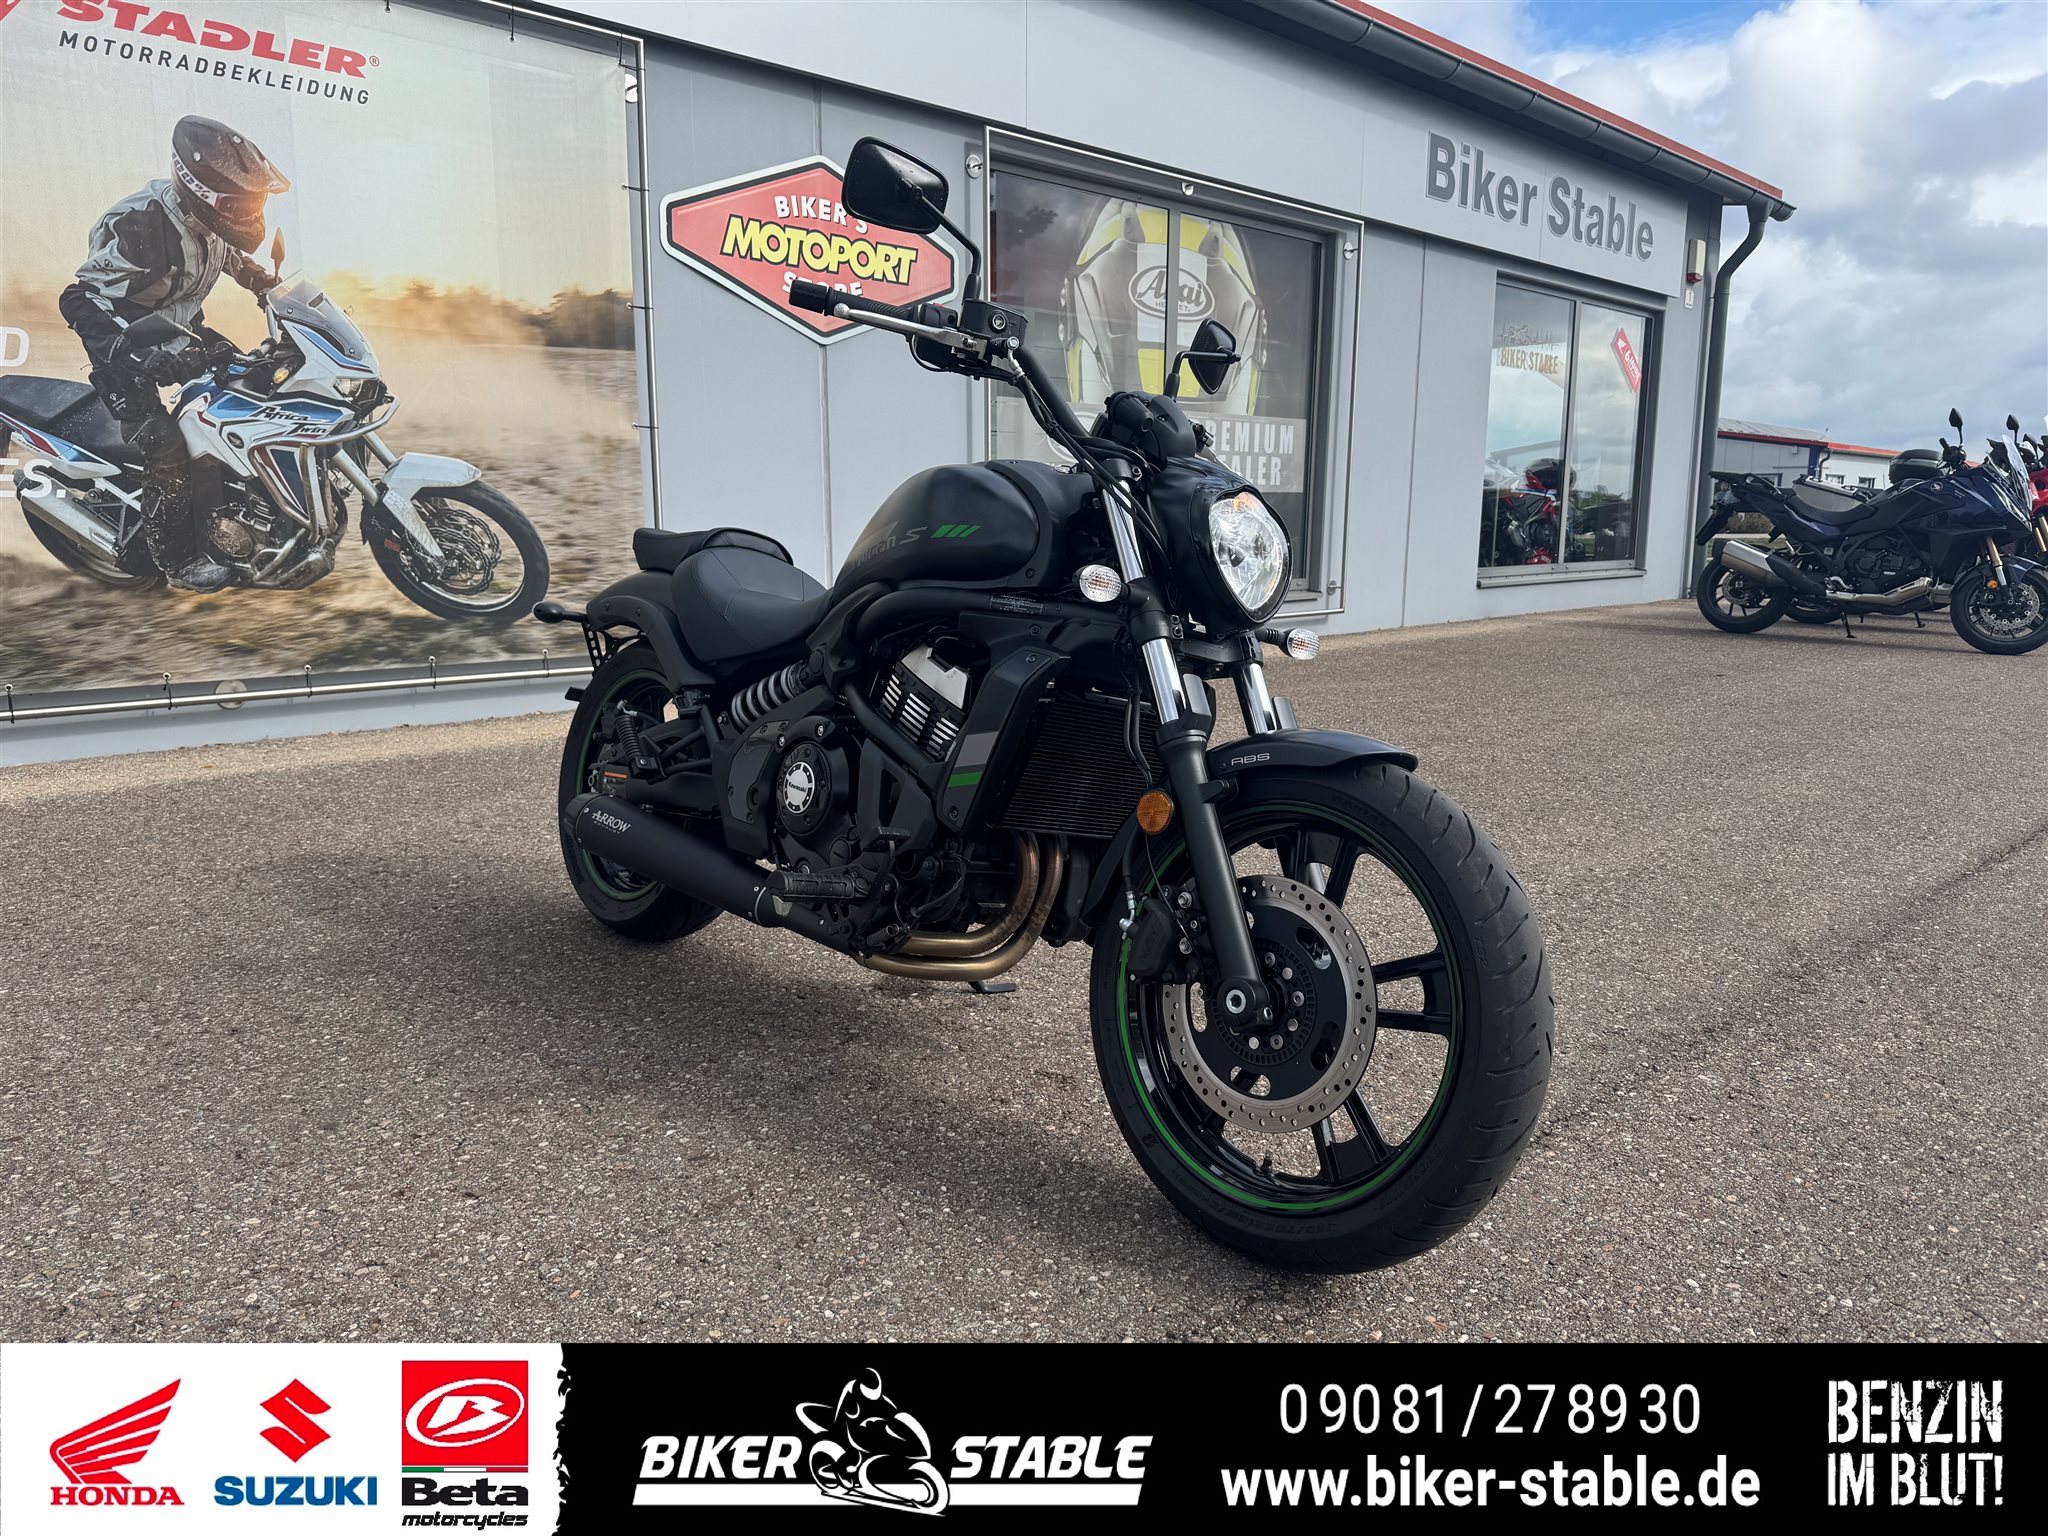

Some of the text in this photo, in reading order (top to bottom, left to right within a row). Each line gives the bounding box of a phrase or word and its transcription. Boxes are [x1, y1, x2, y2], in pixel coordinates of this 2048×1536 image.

[59, 30, 370, 105] MOTORRADBEKLEIDUNG
[1426, 130, 1654, 261] Biker Stable
[721, 215, 918, 285] MOTOPORT
[1135, 269, 1204, 307] Aai
[1501, 347, 1527, 370] BIKER
[249, 405, 310, 421] Africa
[286, 422, 328, 436] Twin
[1205, 420, 1294, 454] REMIUM
[899, 526, 928, 545] S
[1231, 752, 1270, 766] ABS
[592, 810, 631, 833] ARROW
